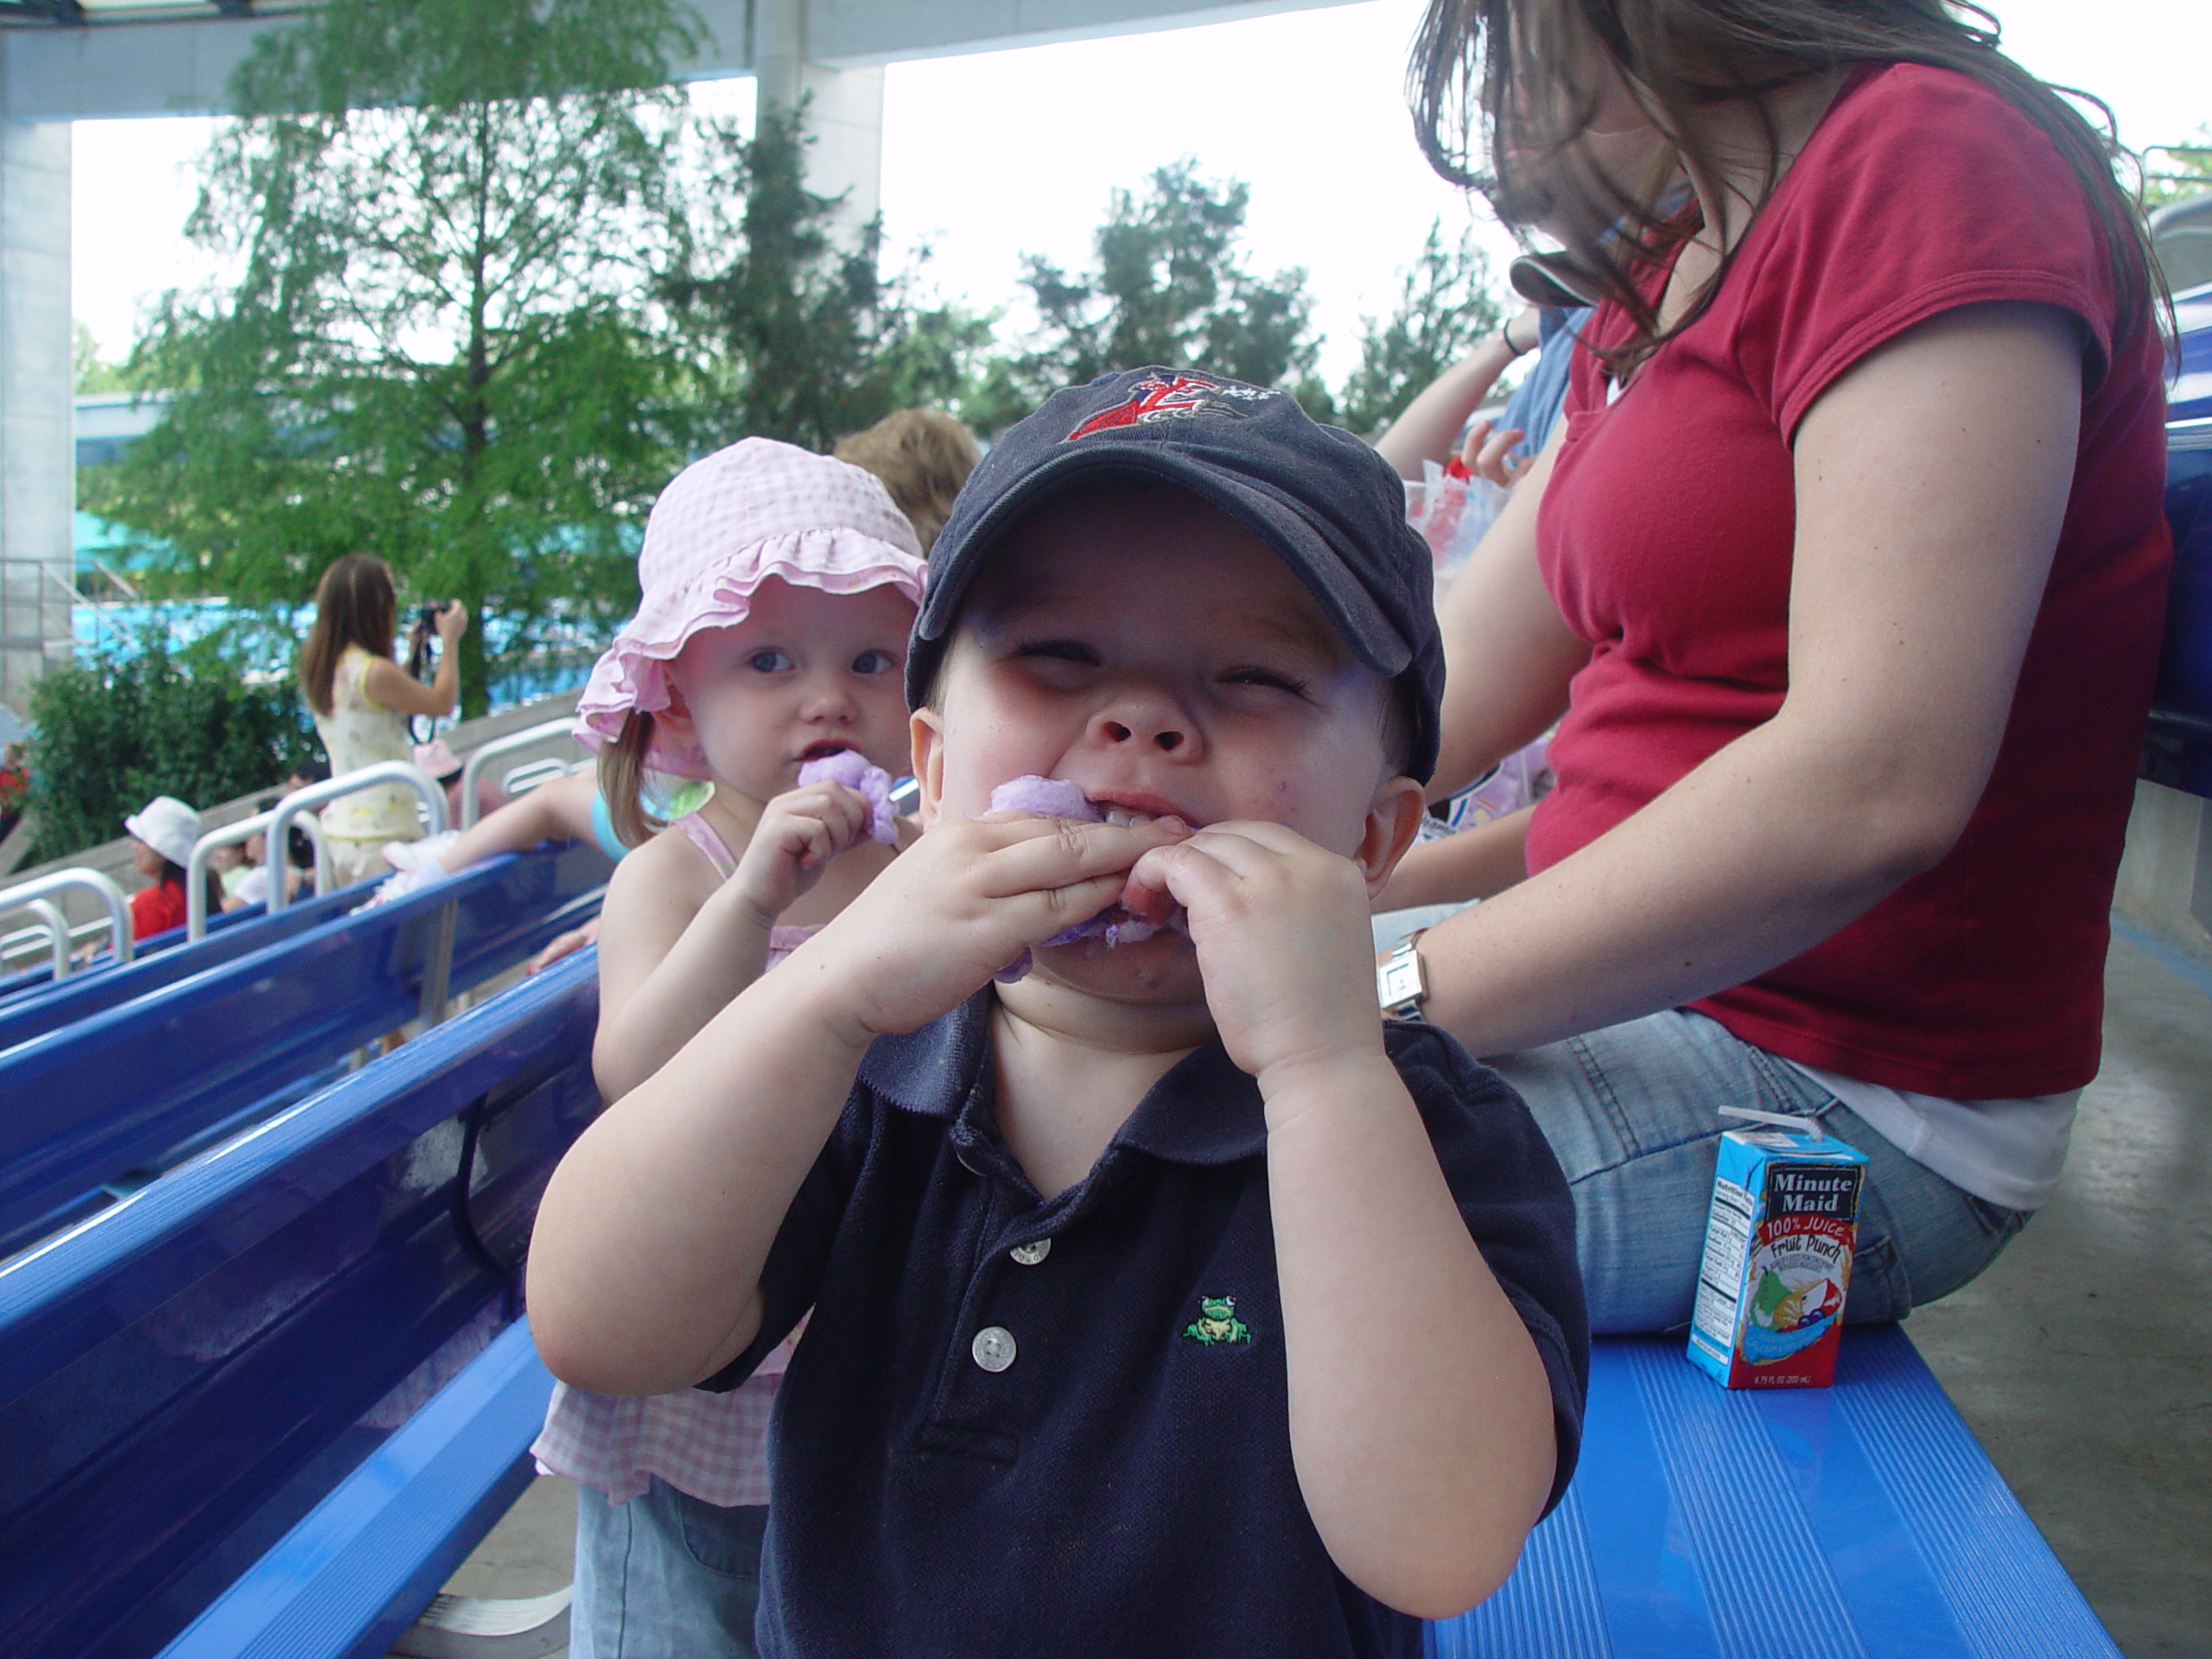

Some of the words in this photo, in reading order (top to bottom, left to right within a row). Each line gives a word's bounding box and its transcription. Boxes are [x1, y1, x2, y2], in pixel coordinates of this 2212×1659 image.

[1774, 1173, 1853, 1192] Minute
[1782, 1193, 1840, 1211] Maid
[1767, 1217, 1801, 1240] 100%
[1803, 1216, 1846, 1236] JUICE
[1770, 1234, 1802, 1259] Fruit
[1806, 1235, 1841, 1264] Punch
